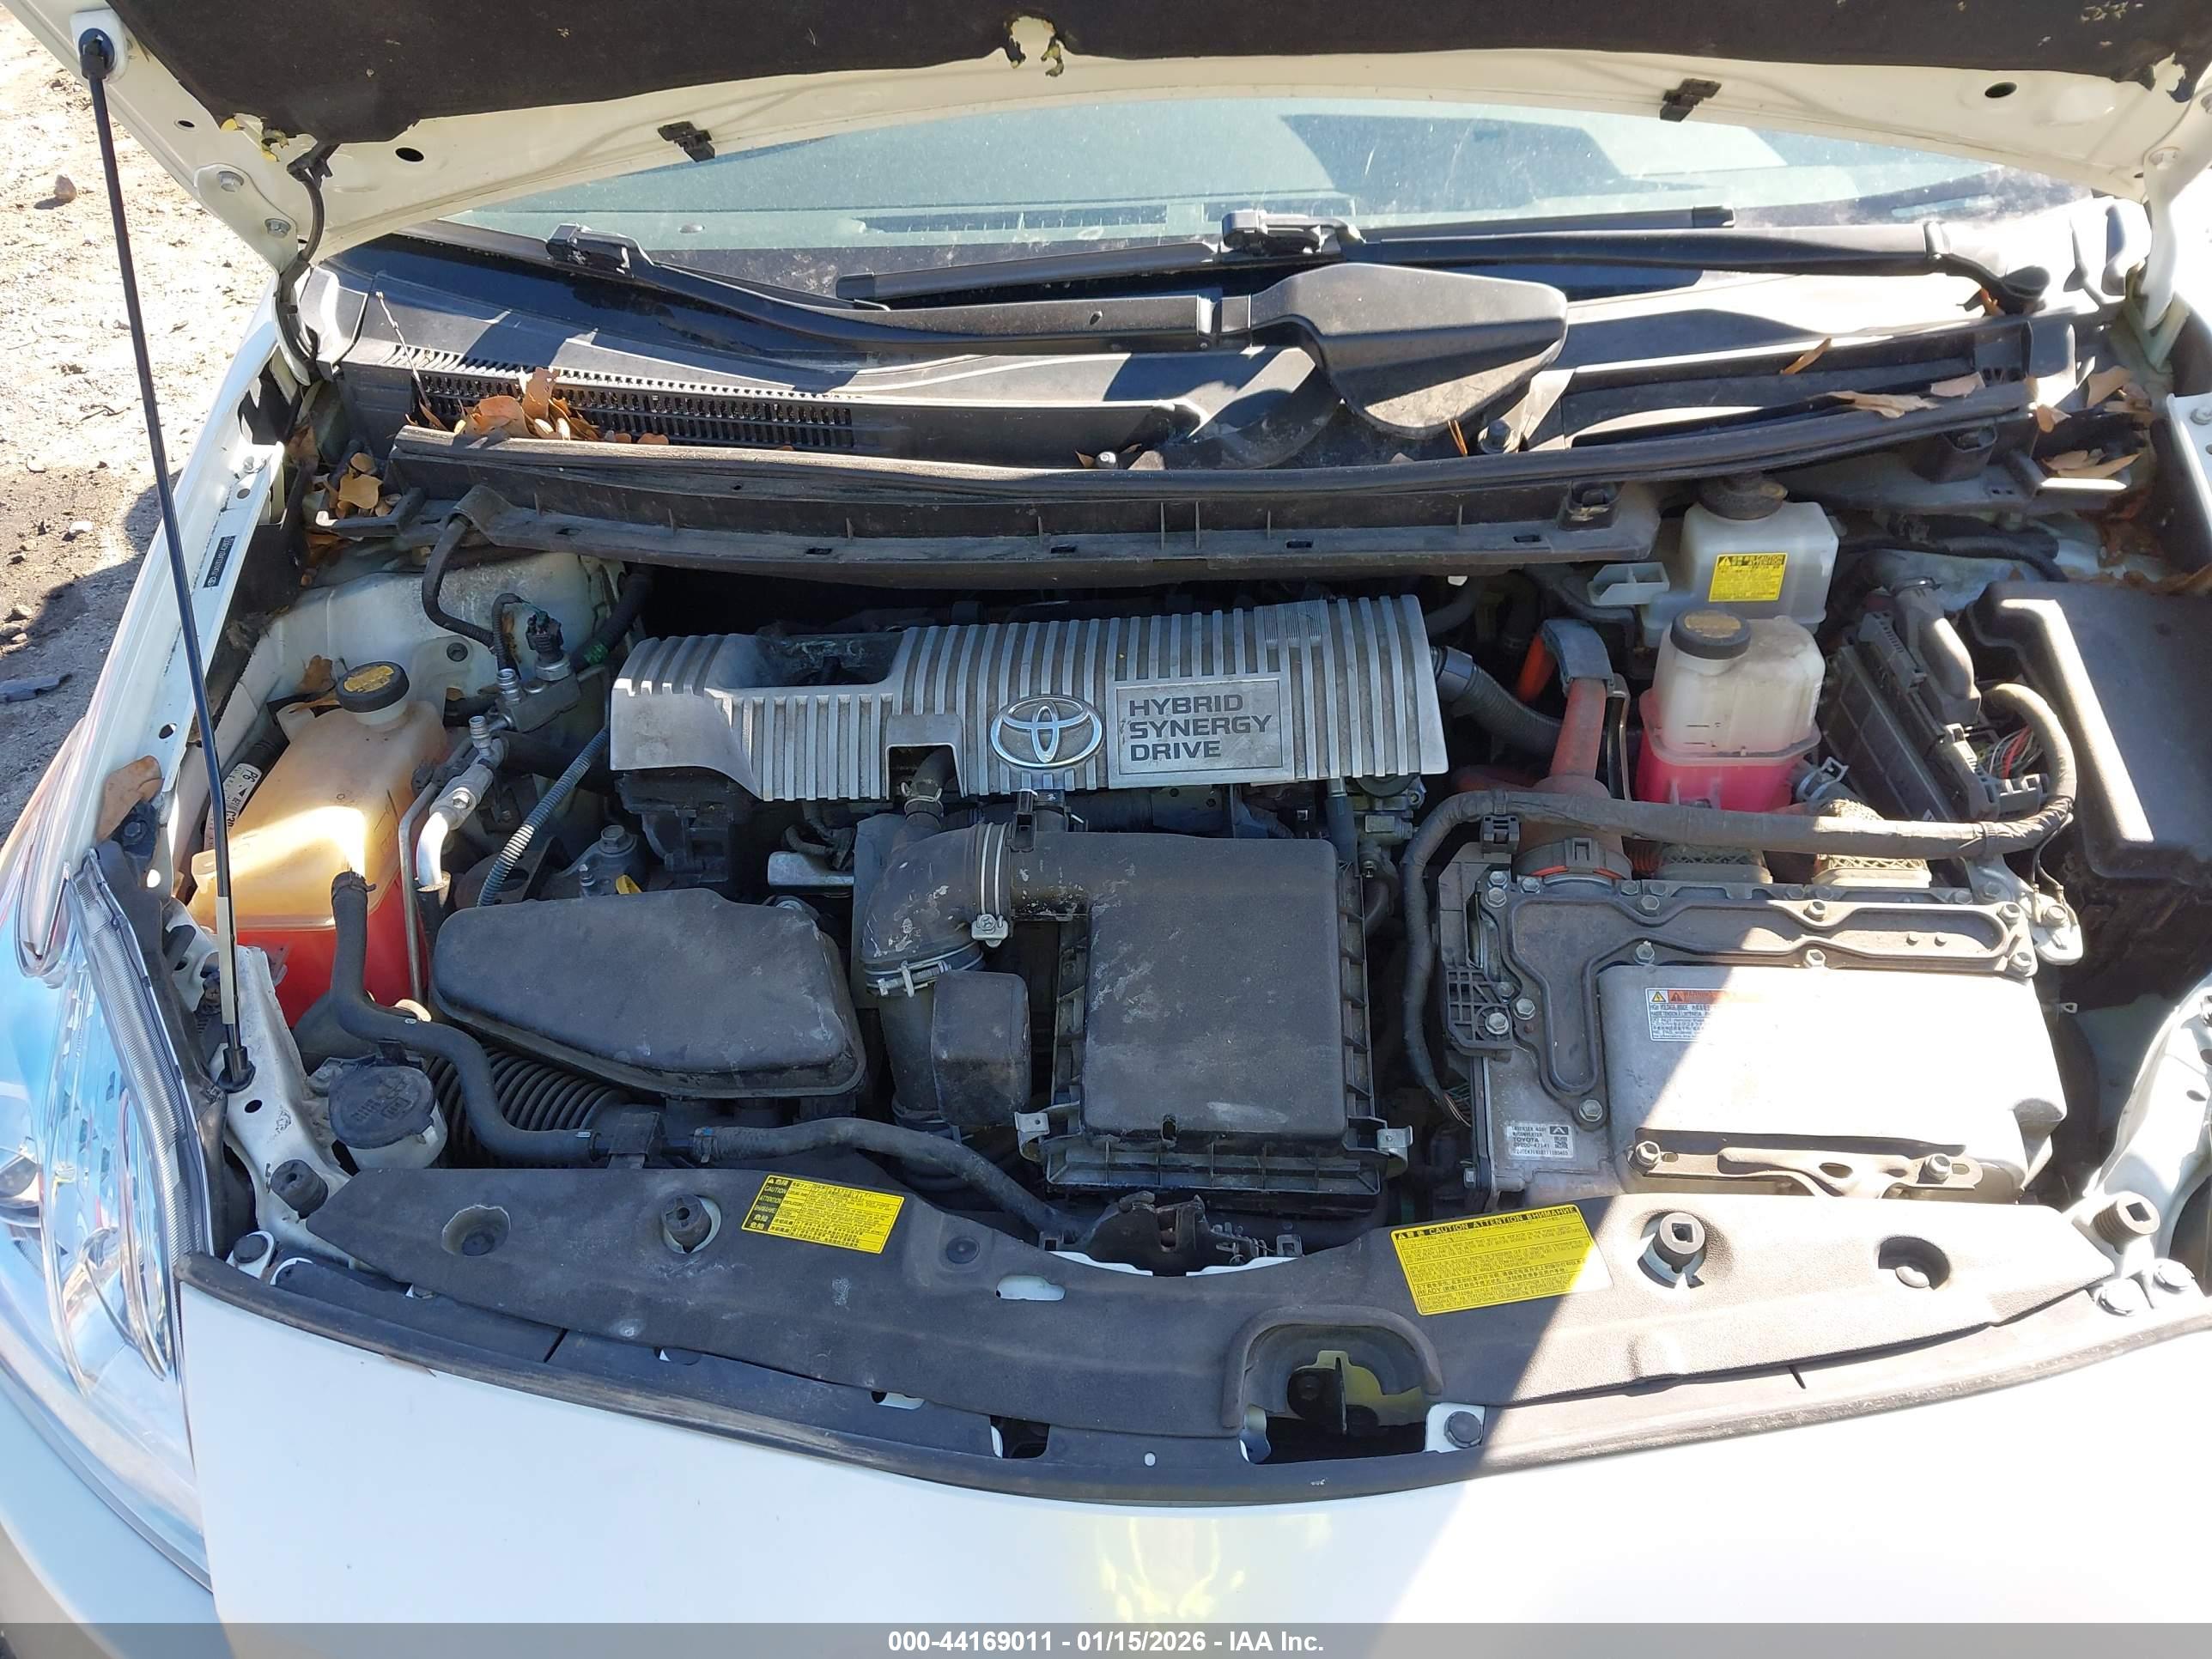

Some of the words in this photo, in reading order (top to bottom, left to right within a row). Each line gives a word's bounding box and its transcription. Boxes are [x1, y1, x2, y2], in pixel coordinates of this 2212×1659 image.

[1129, 694, 1243, 717] HYBRID
[1129, 714, 1272, 739] SYNERGY
[1130, 740, 1222, 762] DRIVE
[763, 1185, 787, 1194] CAUTION
[1428, 1223, 1469, 1234] CAUTION
[1471, 1215, 1523, 1228] ATTENTION
[1525, 1206, 1575, 1219] ВНИМАНИЕ
